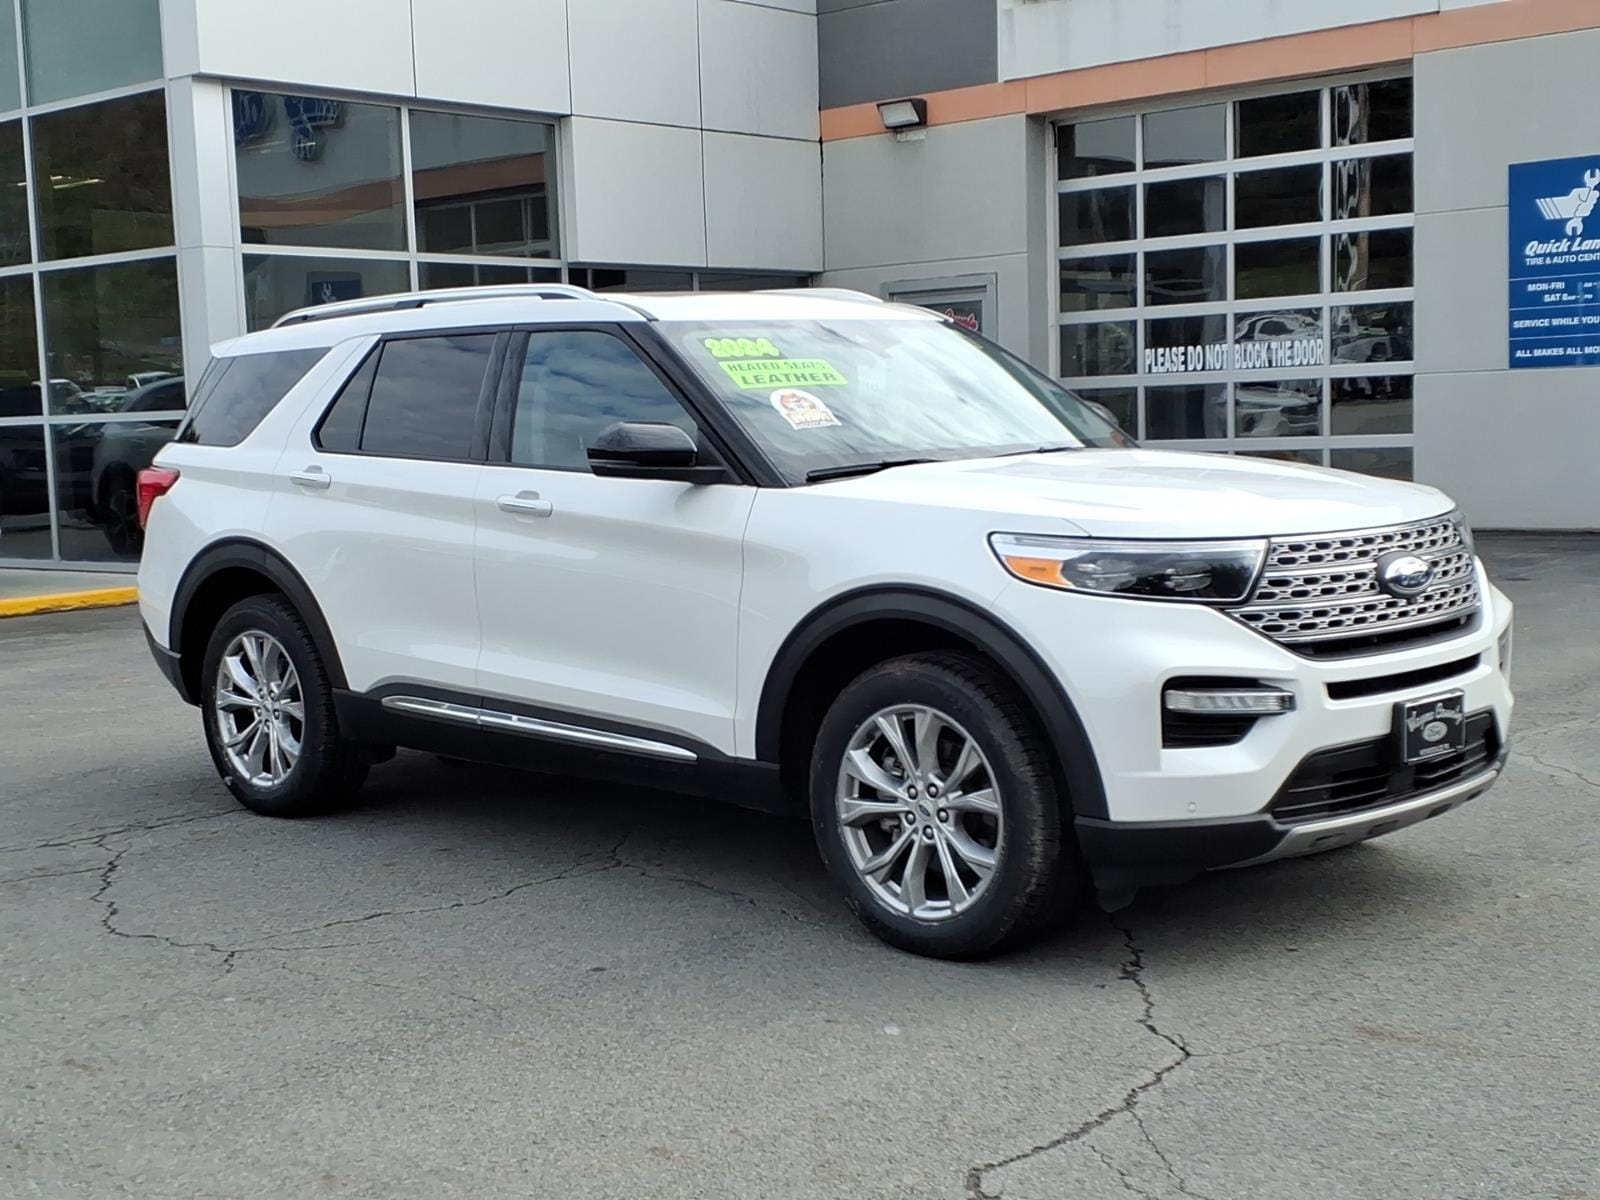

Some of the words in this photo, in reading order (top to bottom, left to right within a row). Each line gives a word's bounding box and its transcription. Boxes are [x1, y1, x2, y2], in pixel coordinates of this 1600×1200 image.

[1525, 238, 1571, 256] Quick
[1526, 257, 1545, 266] TIRE
[1553, 254, 1576, 263] AUTO
[1528, 282, 1565, 291] MON-FRI
[1544, 293, 1561, 302] SAT
[1513, 319, 1550, 328] SERVICE
[1552, 317, 1580, 325] WHILE
[1581, 315, 1600, 324] YOU
[704, 338, 780, 357] 2024
[1534, 347, 1565, 356] MAKES
[1566, 347, 1583, 355] ALL
[1145, 346, 1186, 373] PLEASE
[1187, 344, 1204, 371] DO
[1205, 343, 1228, 369] NOT
[1234, 341, 1269, 369] BLOCK
[1270, 341, 1295, 367] THE
[1294, 339, 1324, 365] DOOR
[727, 362, 779, 372] HEATED
[784, 361, 826, 370] SEATS
[741, 373, 837, 385] LEATHER
